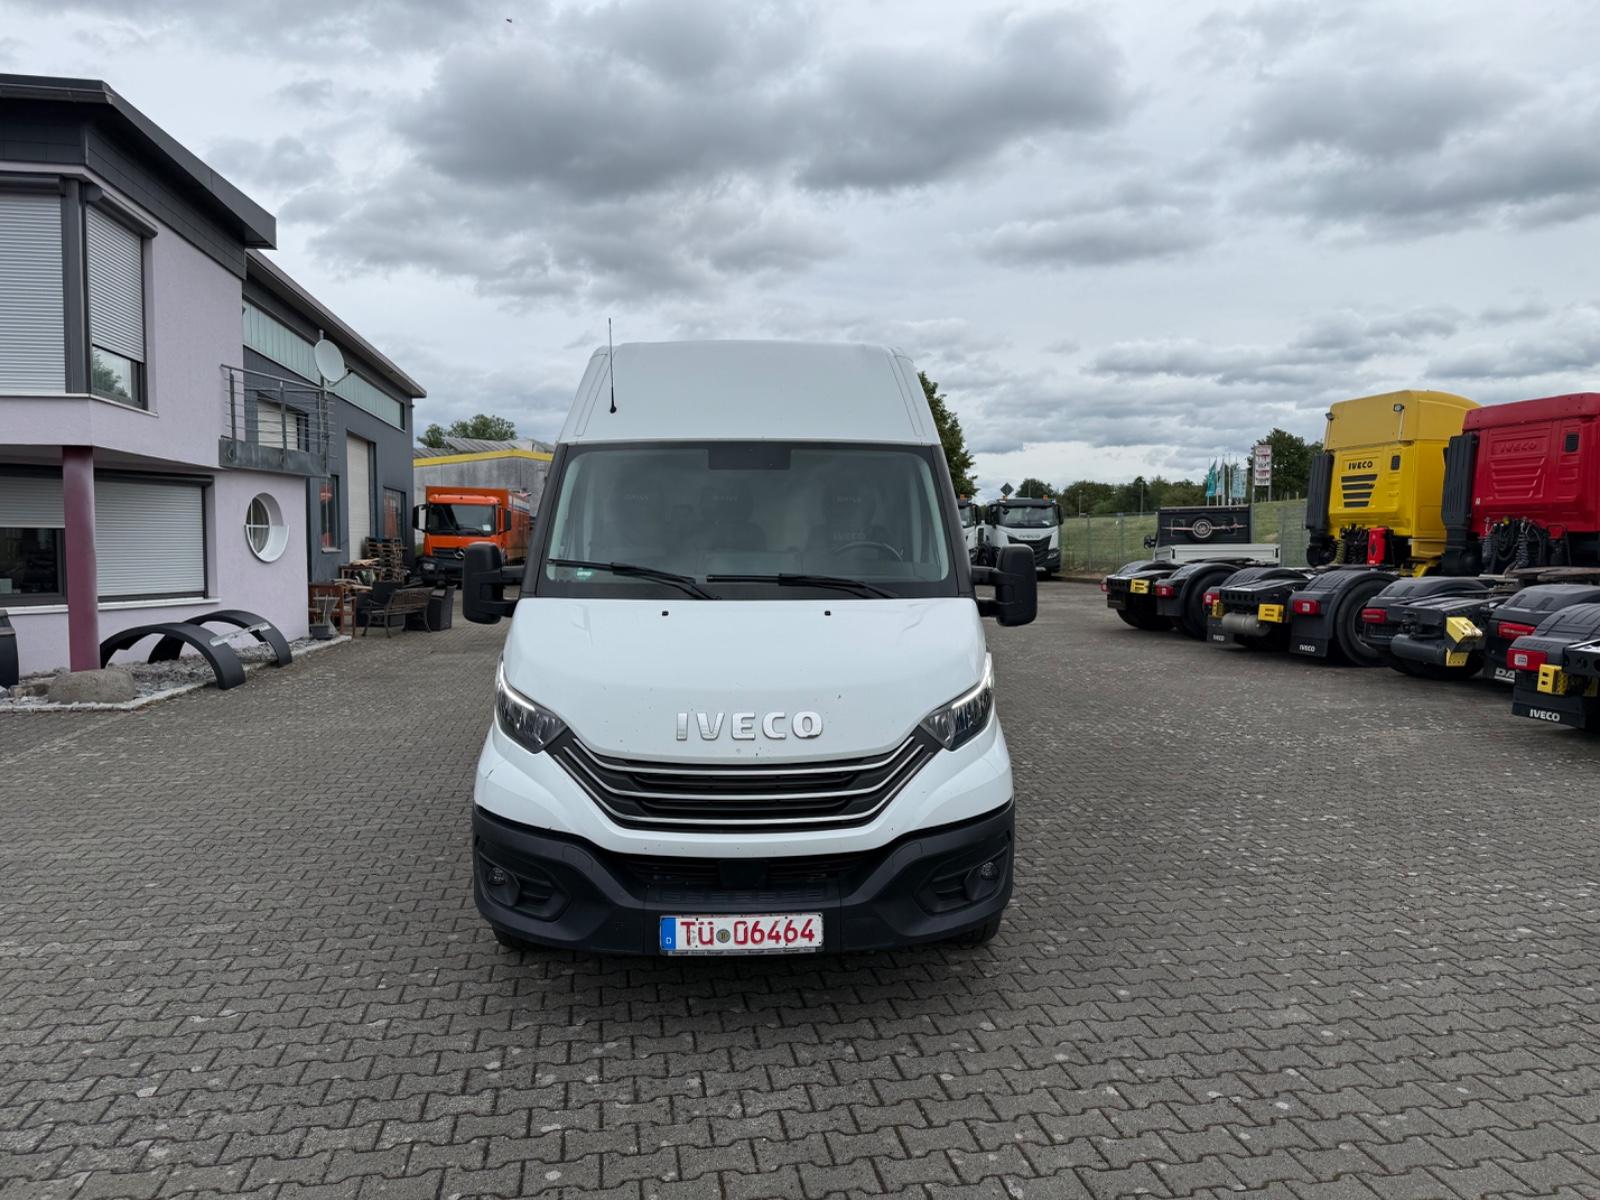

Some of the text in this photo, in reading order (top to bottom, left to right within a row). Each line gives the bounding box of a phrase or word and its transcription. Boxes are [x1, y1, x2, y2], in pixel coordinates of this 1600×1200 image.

[1500, 440, 1537, 453] IVECO
[1348, 460, 1373, 470] IVECO
[1495, 667, 1515, 679] DA
[1529, 708, 1561, 722] IVECO
[676, 711, 824, 741] IVECO
[680, 918, 815, 946] TÜ 06464
